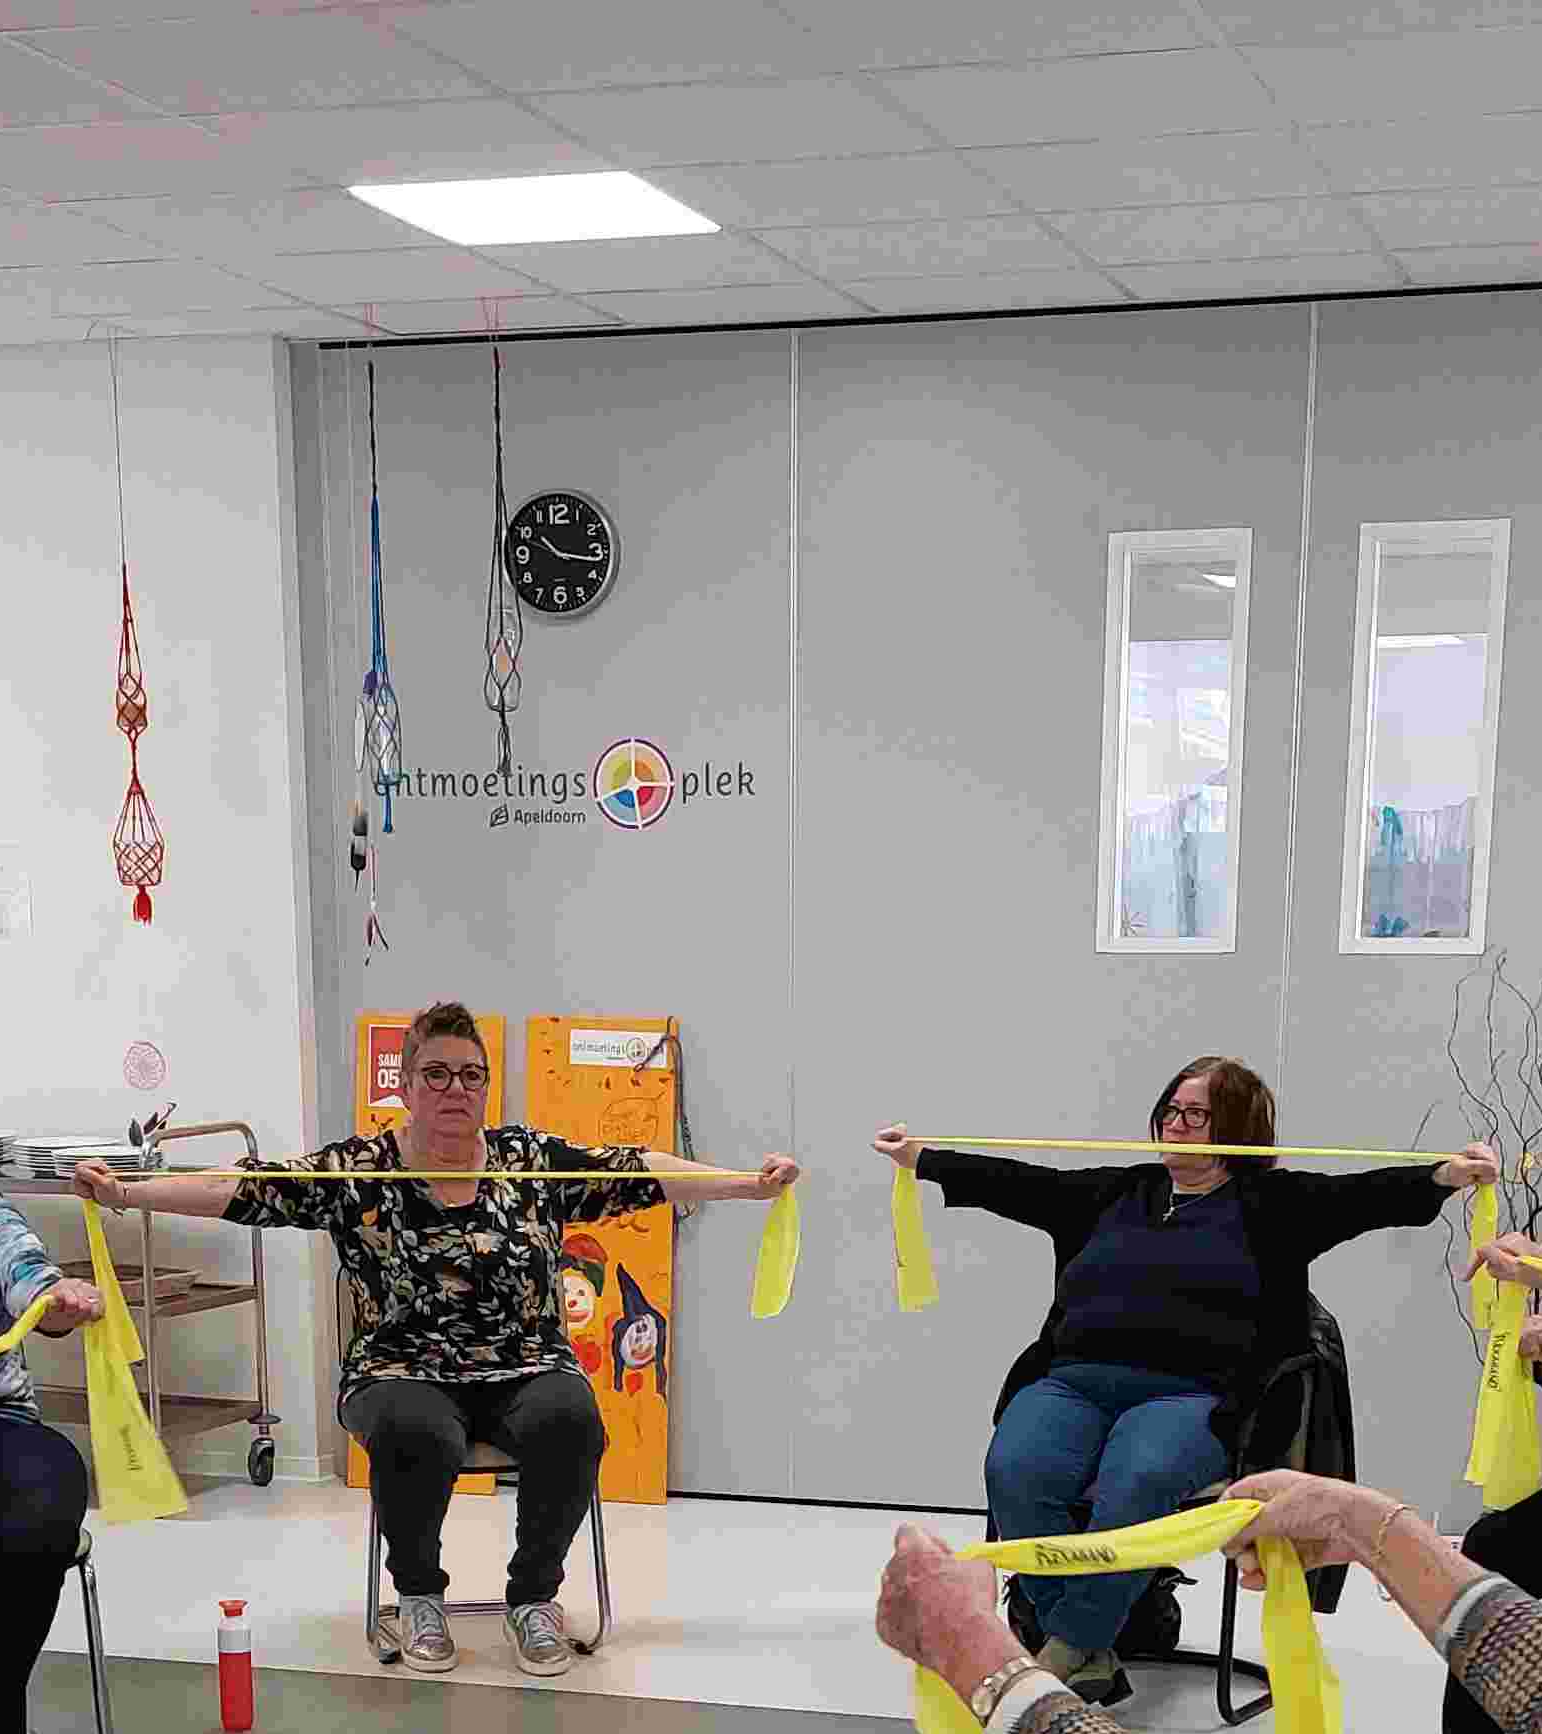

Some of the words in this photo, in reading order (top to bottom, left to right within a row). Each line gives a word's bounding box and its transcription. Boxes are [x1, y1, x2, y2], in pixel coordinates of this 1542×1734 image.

[549, 504, 570, 525] 12
[519, 526, 532, 539] 10
[586, 524, 597, 536] 2
[516, 545, 530, 564] 9
[589, 543, 603, 562] 3
[522, 571, 533, 583] 8
[587, 569, 597, 580] 4
[534, 588, 545, 604] 7
[554, 586, 568, 604] 6
[575, 586, 585, 598] 5
[681, 762, 757, 803] plek
[513, 808, 587, 828] Apeldoorn
